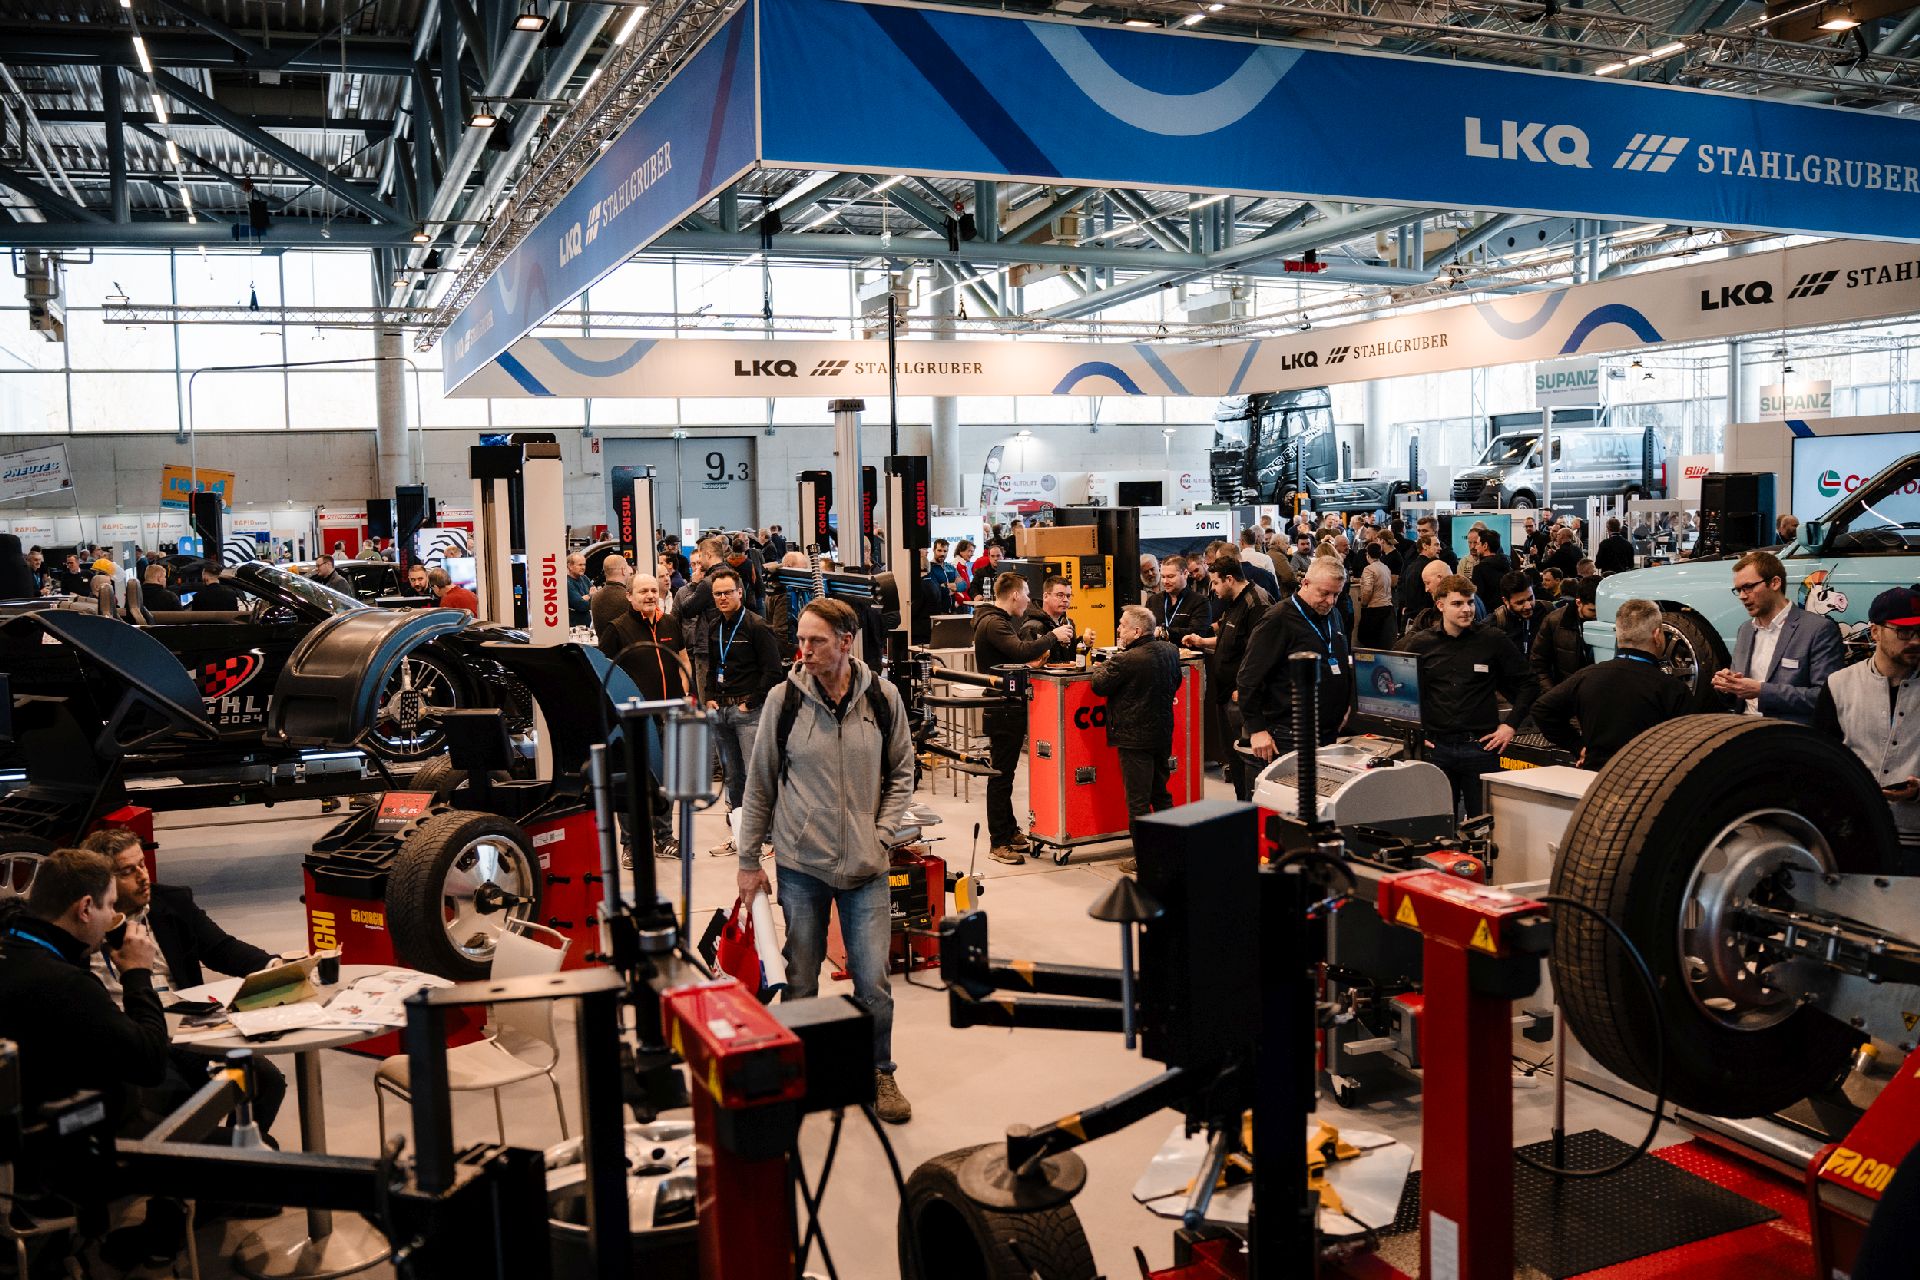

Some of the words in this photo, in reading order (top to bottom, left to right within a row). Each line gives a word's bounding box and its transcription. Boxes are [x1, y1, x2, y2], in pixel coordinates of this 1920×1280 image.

[1465, 117, 1593, 168] LKQ
[1698, 144, 1920, 194] STAHLGRUBER
[560, 222, 582, 268] LKQ
[602, 141, 673, 227] STAHLGRUBER
[1701, 281, 1774, 311] LKQ
[1846, 260, 1920, 288] STAH
[734, 360, 798, 377] LKQ
[1281, 351, 1318, 370] LKQ
[1353, 333, 1448, 359] STAHLGRUBER
[1536, 369, 1598, 390] SUPANZ
[1760, 393, 1831, 411] SUPANZ
[706, 452, 749, 481] 9.3
[1685, 466, 1709, 476] Blitz
[622, 496, 632, 542] CONSUL
[819, 496, 827, 534] CONSUL
[863, 491, 871, 533] CONSUL
[917, 480, 926, 527] CONSUL
[543, 553, 558, 628] CONSUL
[219, 714, 263, 725] 2024
